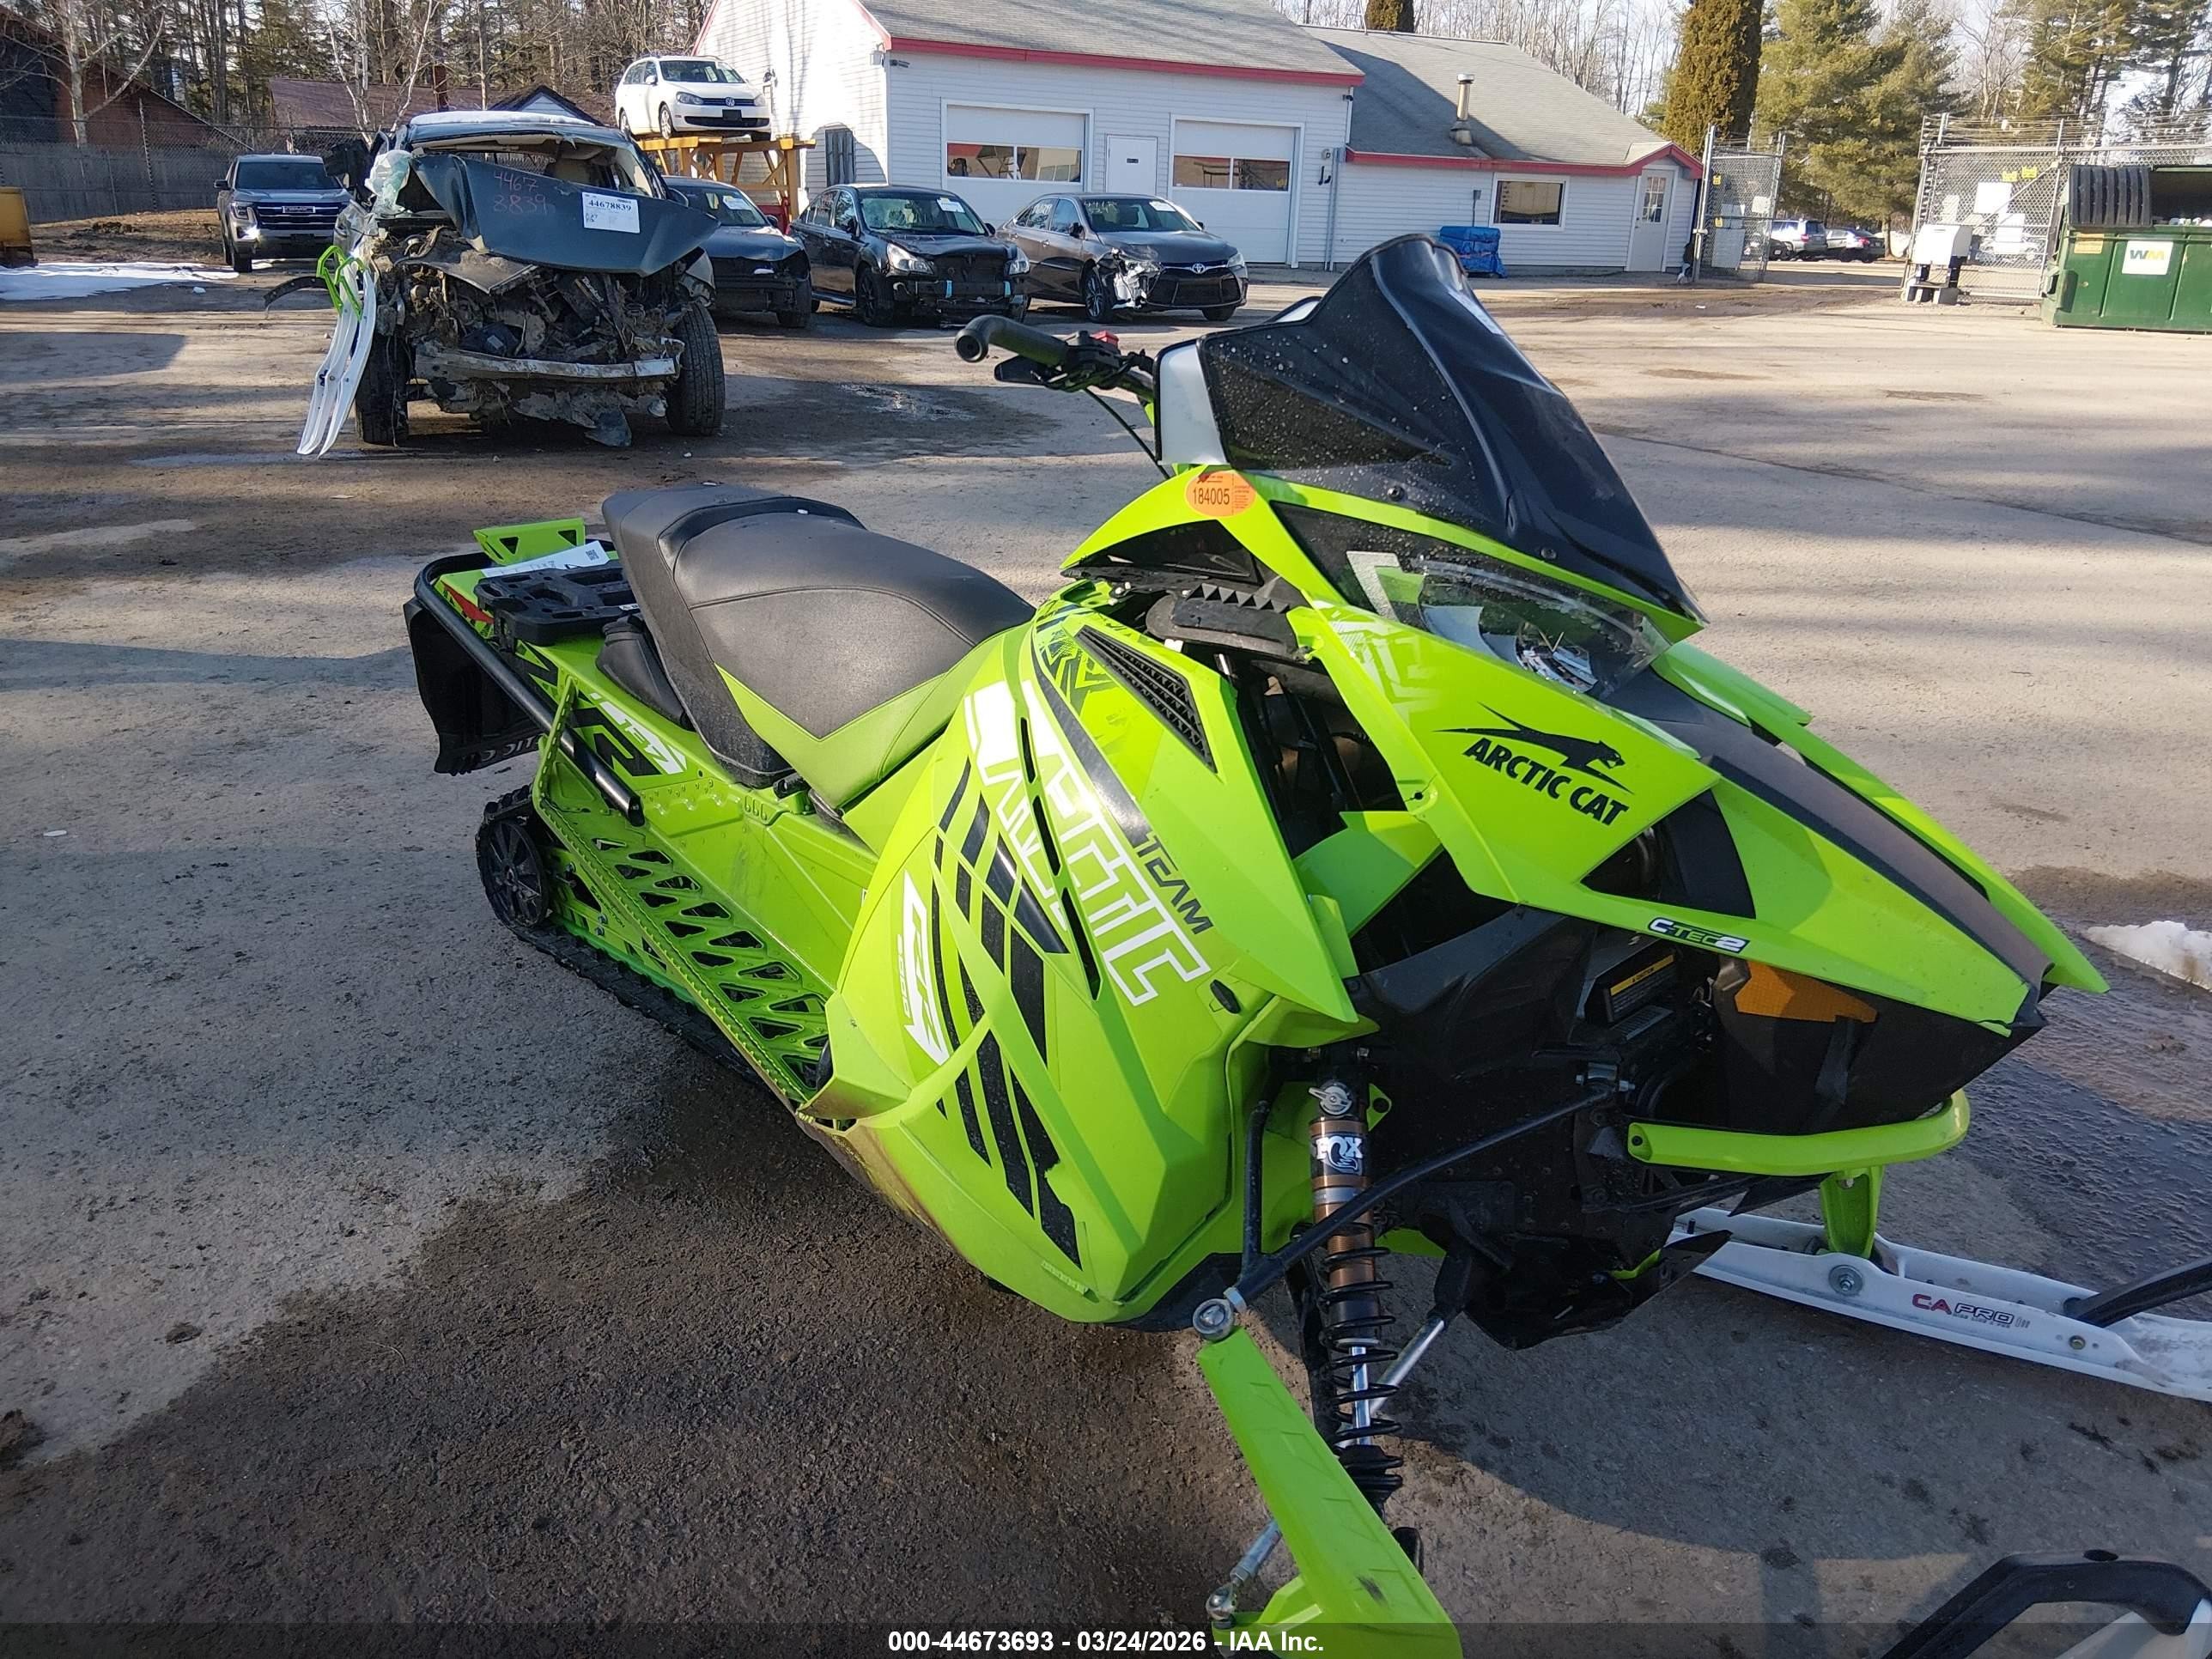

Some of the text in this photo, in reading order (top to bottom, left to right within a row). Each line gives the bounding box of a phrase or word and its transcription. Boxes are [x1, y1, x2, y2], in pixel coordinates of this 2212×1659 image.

[494, 171, 539, 192] 4467
[588, 198, 632, 212] 44678839
[2130, 249, 2165, 260] WM
[1194, 487, 1231, 505] 184005
[1462, 736, 1631, 827] ARCTIC CAT
[1136, 834, 1214, 935] TEAM
[1316, 1136, 1364, 1168] FOX
[1954, 1303, 2015, 1326] PRO
